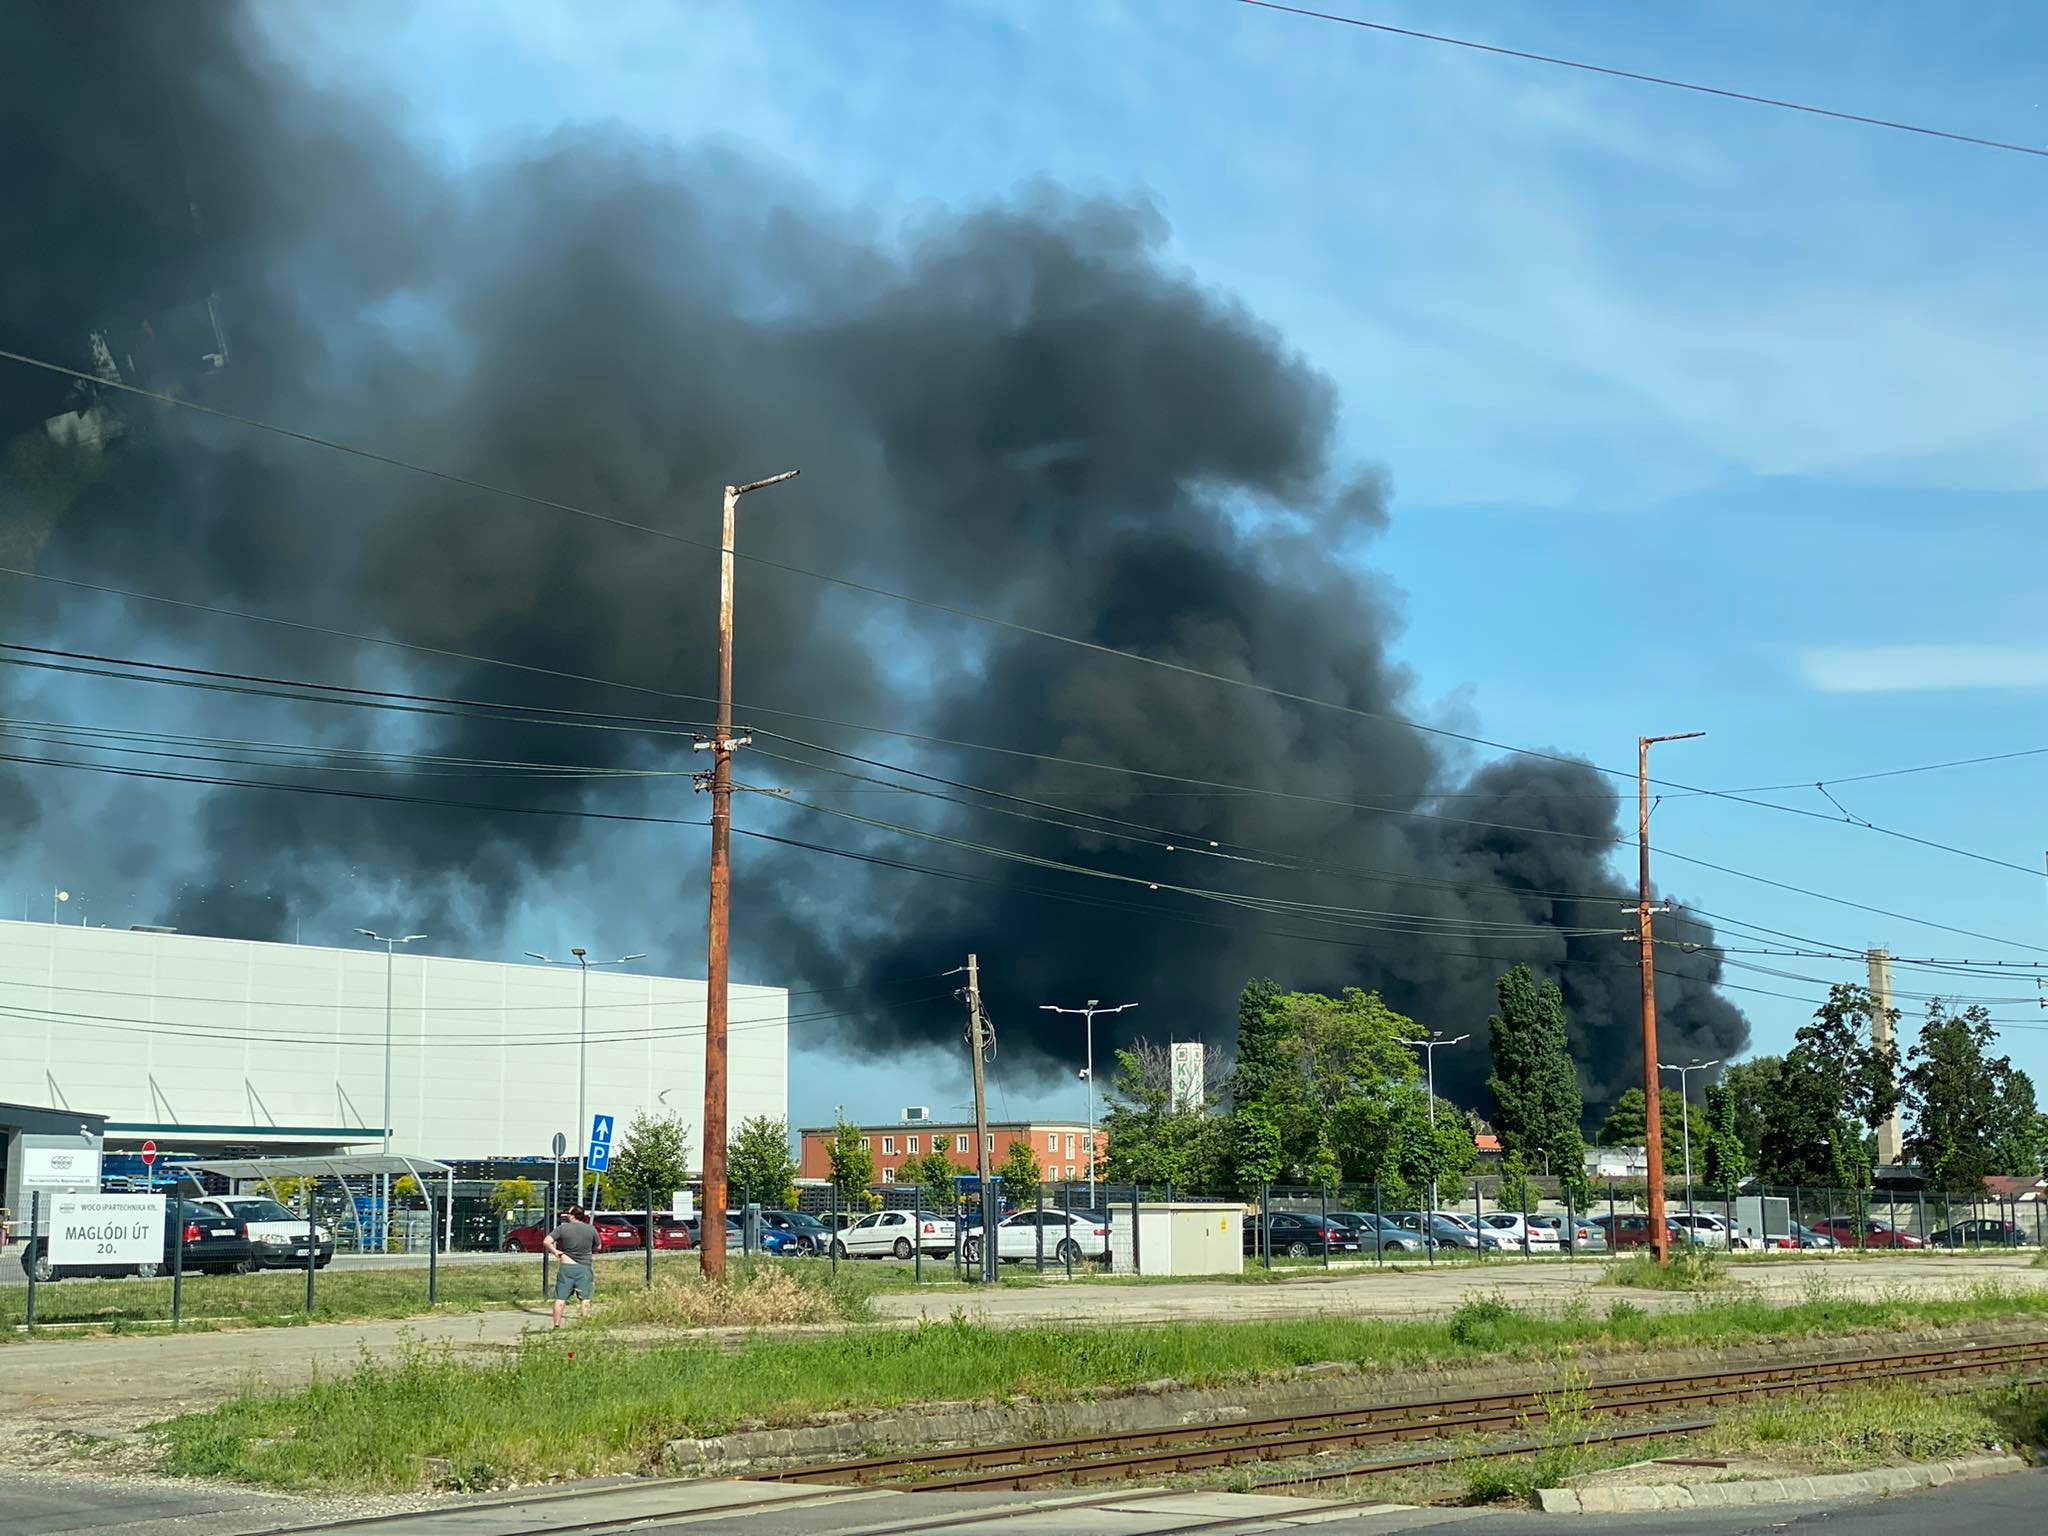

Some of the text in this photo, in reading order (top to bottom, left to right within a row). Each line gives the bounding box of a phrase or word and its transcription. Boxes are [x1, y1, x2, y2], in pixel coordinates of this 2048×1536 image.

[592, 1146, 605, 1166] P
[81, 1203, 101, 1212] WOCO
[65, 1221, 149, 1240] MAGLÓDI ÚT
[97, 1243, 117, 1254] 20.
